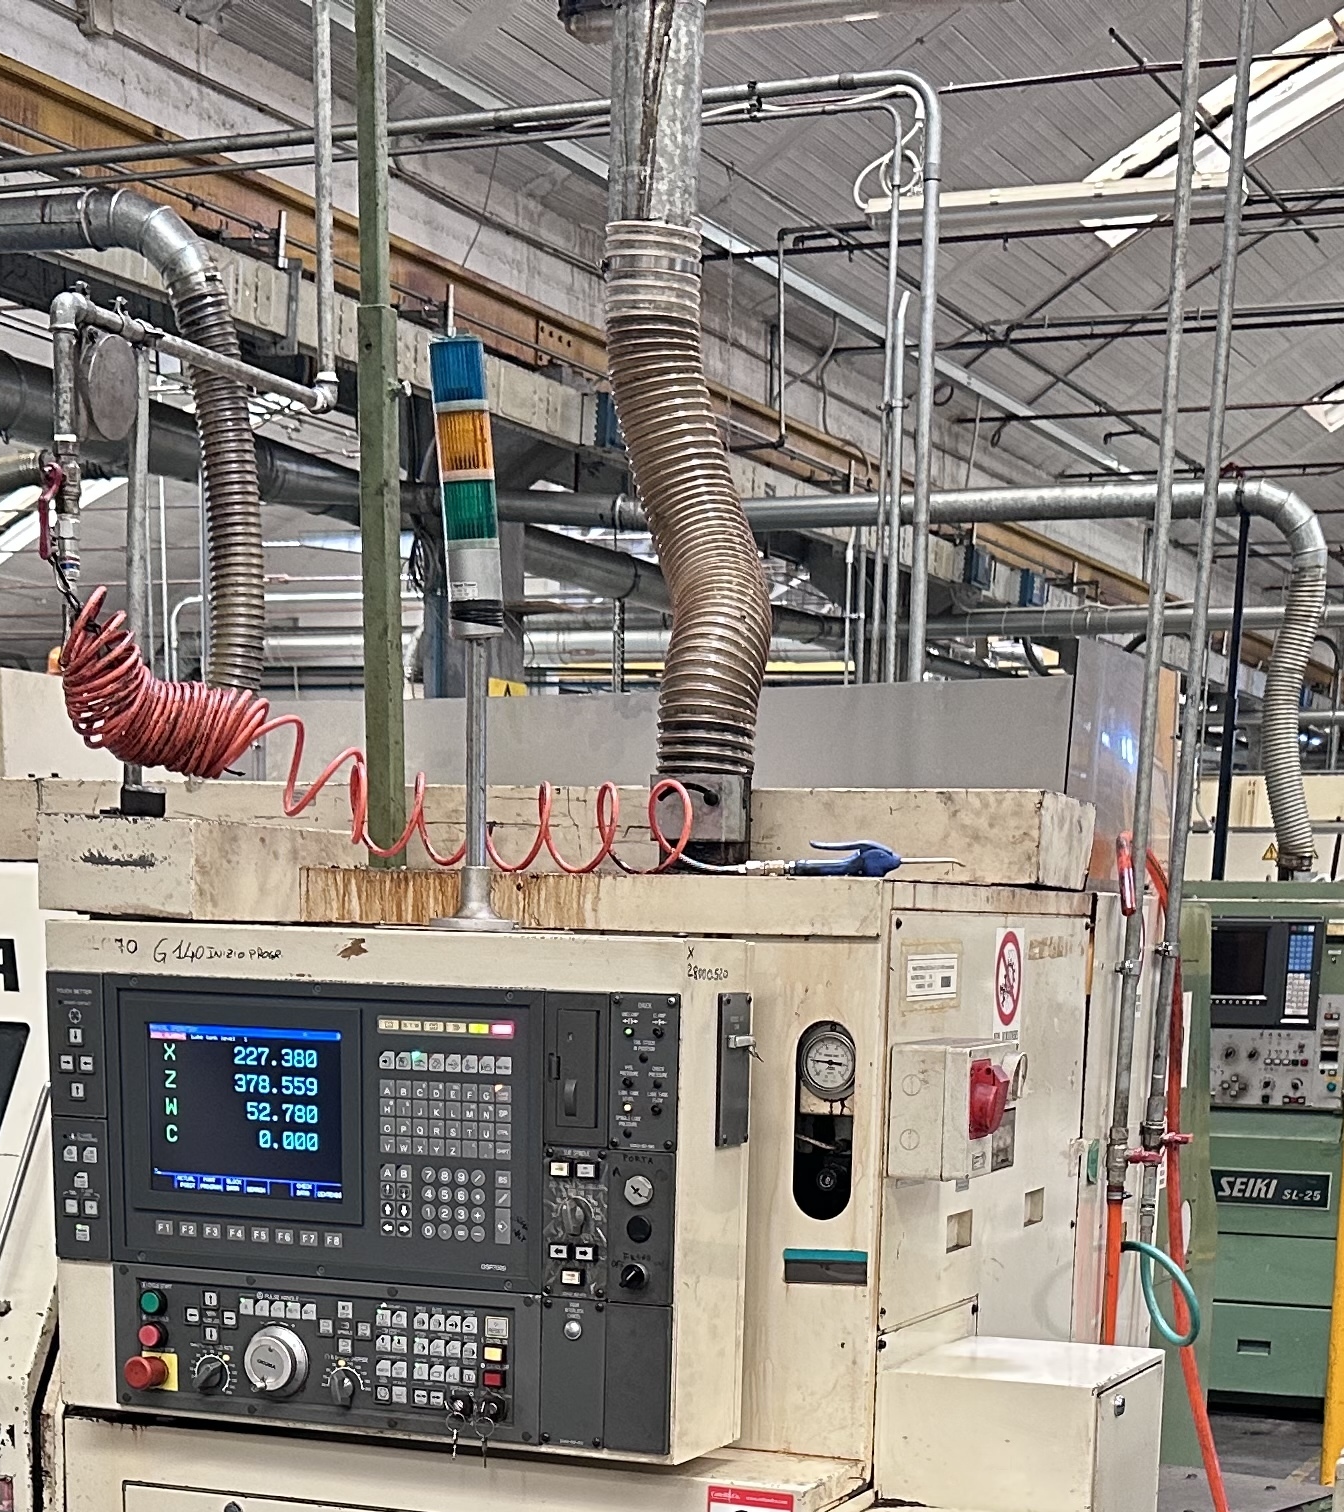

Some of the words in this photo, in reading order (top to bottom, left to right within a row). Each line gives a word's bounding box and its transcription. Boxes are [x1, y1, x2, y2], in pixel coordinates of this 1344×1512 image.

[687, 946, 694, 960] X
[163, 1043, 176, 1061] X
[233, 1046, 318, 1068] 227.380
[164, 1070, 177, 1088] Z
[234, 1073, 318, 1096] 378.559
[165, 1097, 178, 1116] W
[246, 1102, 318, 1124] 52.780
[166, 1124, 178, 1143] C
[259, 1130, 318, 1152] 0.000
[1217, 1177, 1278, 1199] SEIKI
[1282, 1189, 1321, 1201] SL-25
[158, 1223, 170, 1232] F1
[181, 1225, 194, 1234] F2
[205, 1226, 218, 1236] F3
[229, 1228, 242, 1238] F4
[254, 1230, 266, 1240] F5
[277, 1232, 290, 1242] F6
[302, 1234, 315, 1244] F7
[327, 1236, 339, 1246] F8
